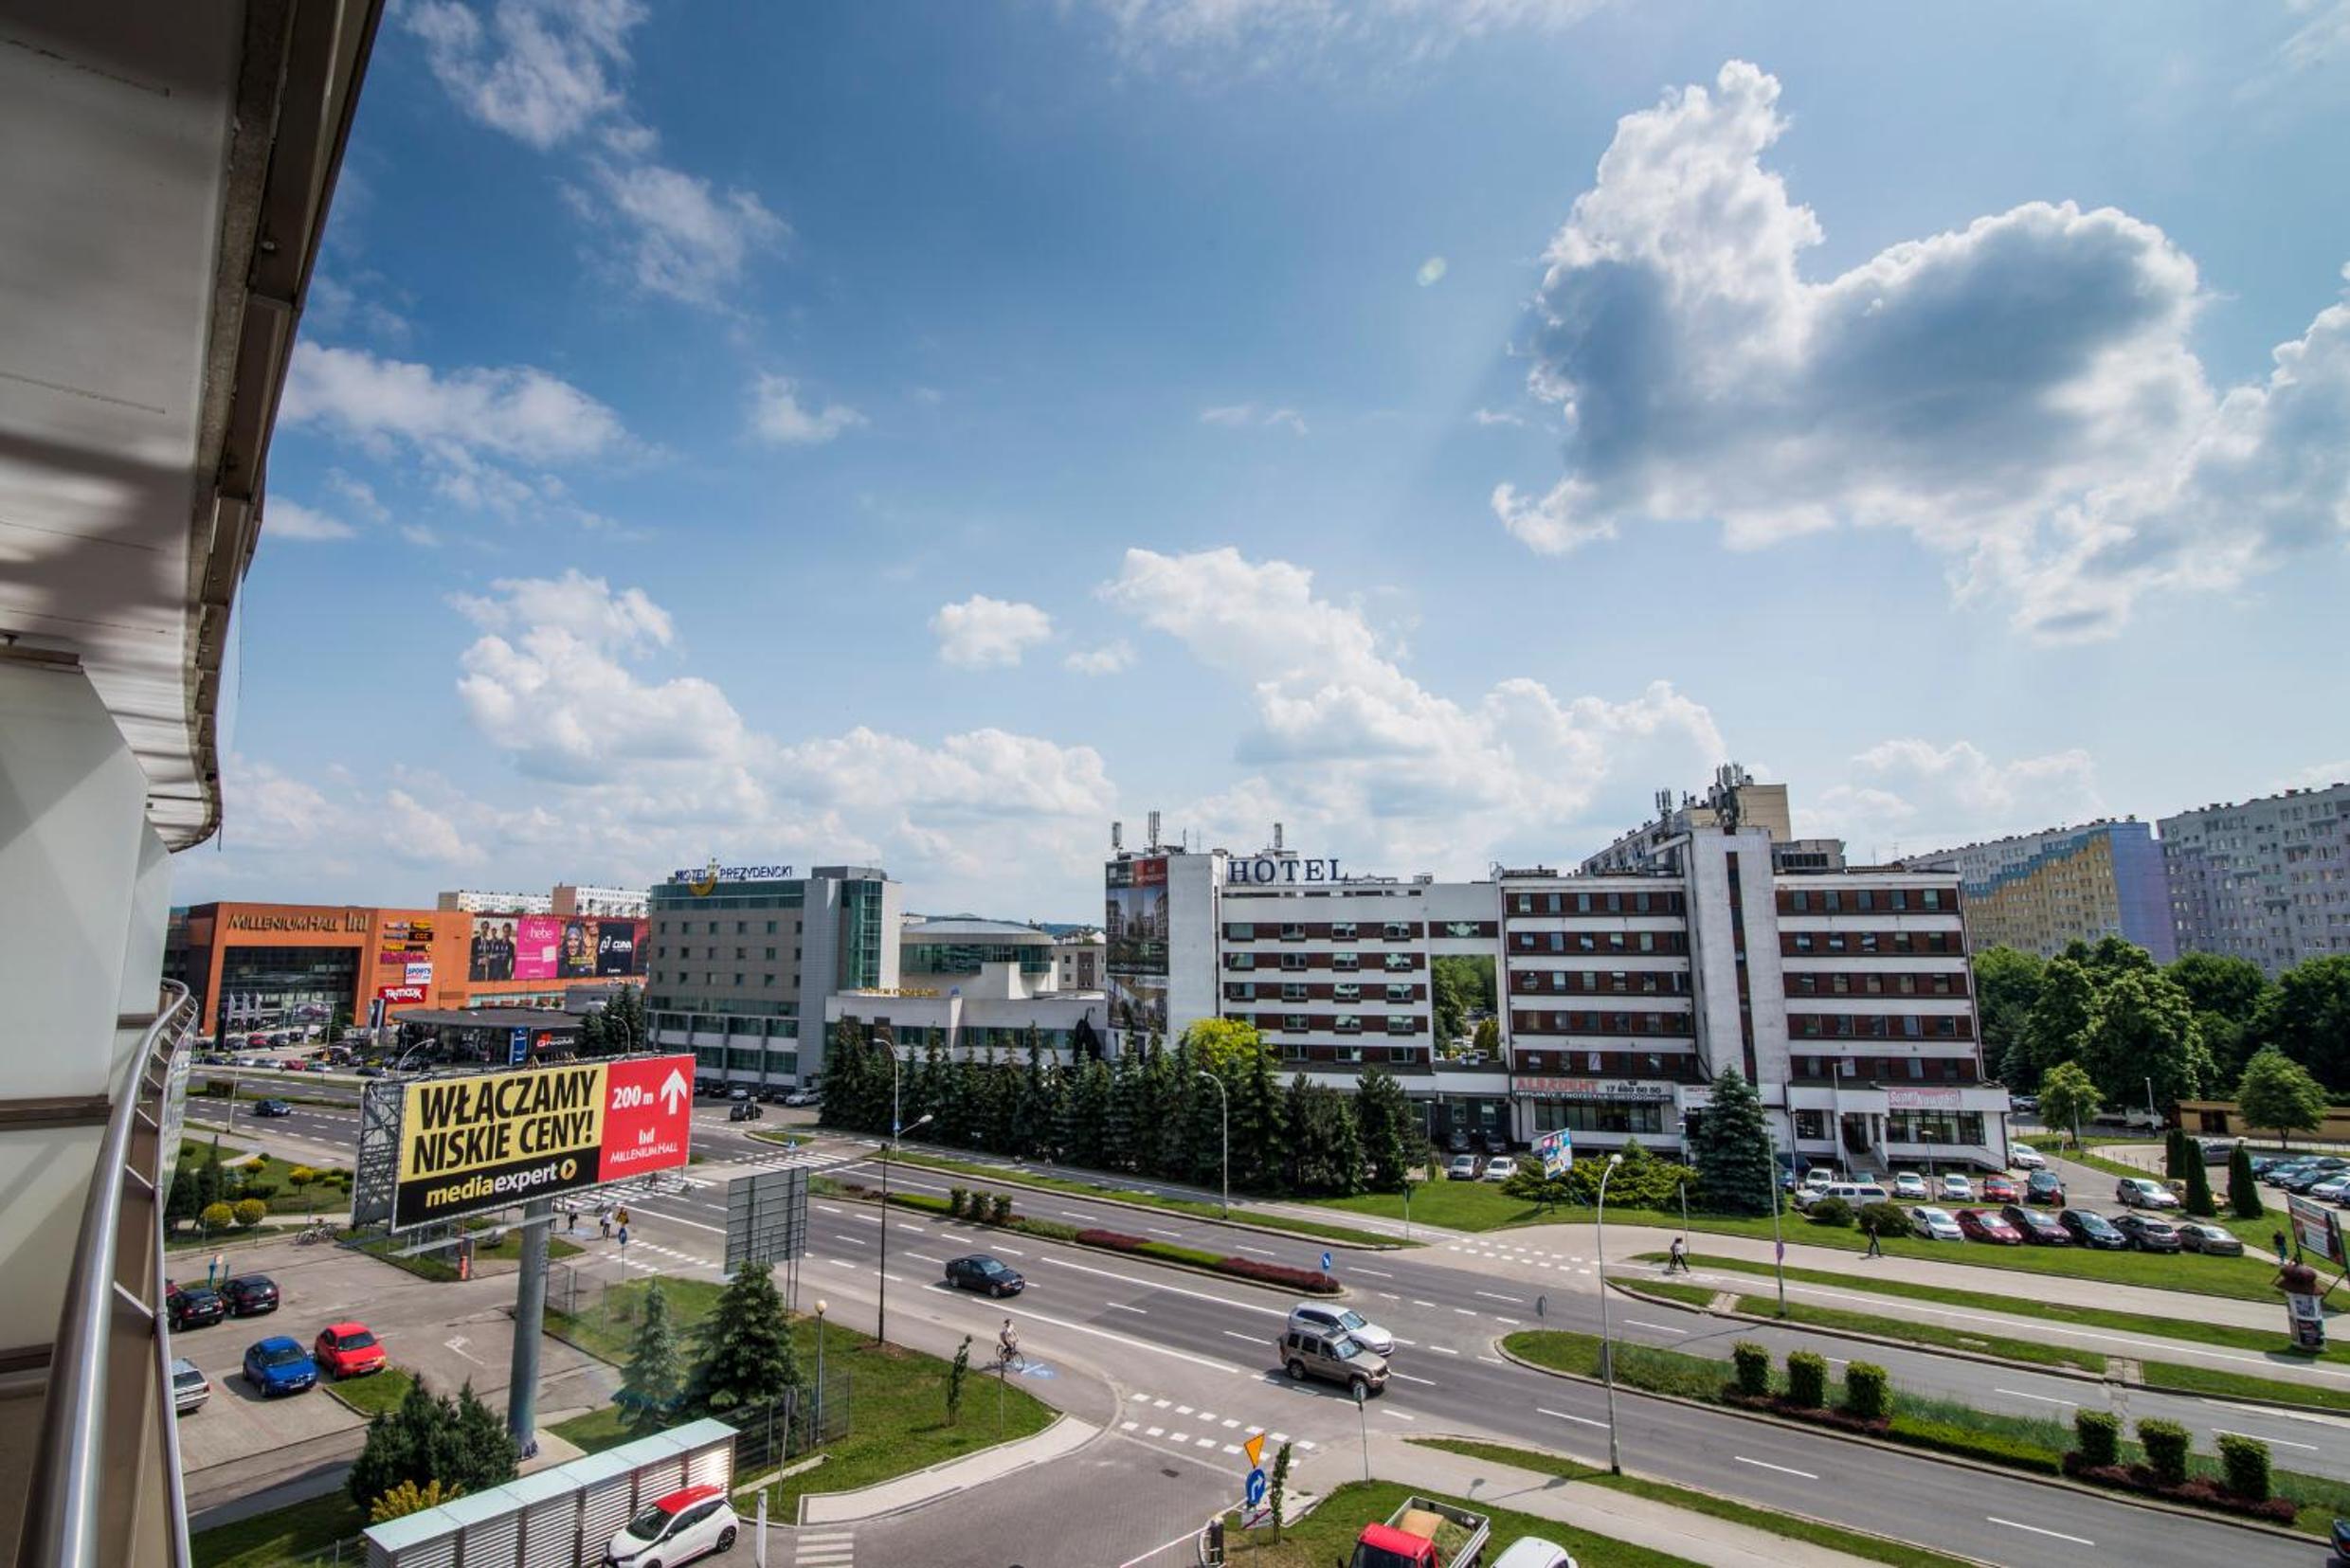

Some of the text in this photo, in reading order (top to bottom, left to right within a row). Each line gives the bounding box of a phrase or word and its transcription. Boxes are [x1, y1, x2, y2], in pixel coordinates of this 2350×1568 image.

[1227, 858, 1348, 883] HOTEL
[420, 1070, 598, 1130] WŁĄCZAMY
[611, 1085, 654, 1109] 200 m
[412, 1109, 594, 1175] NISKIE CENY!
[425, 1162, 558, 1208] mediaexpert
